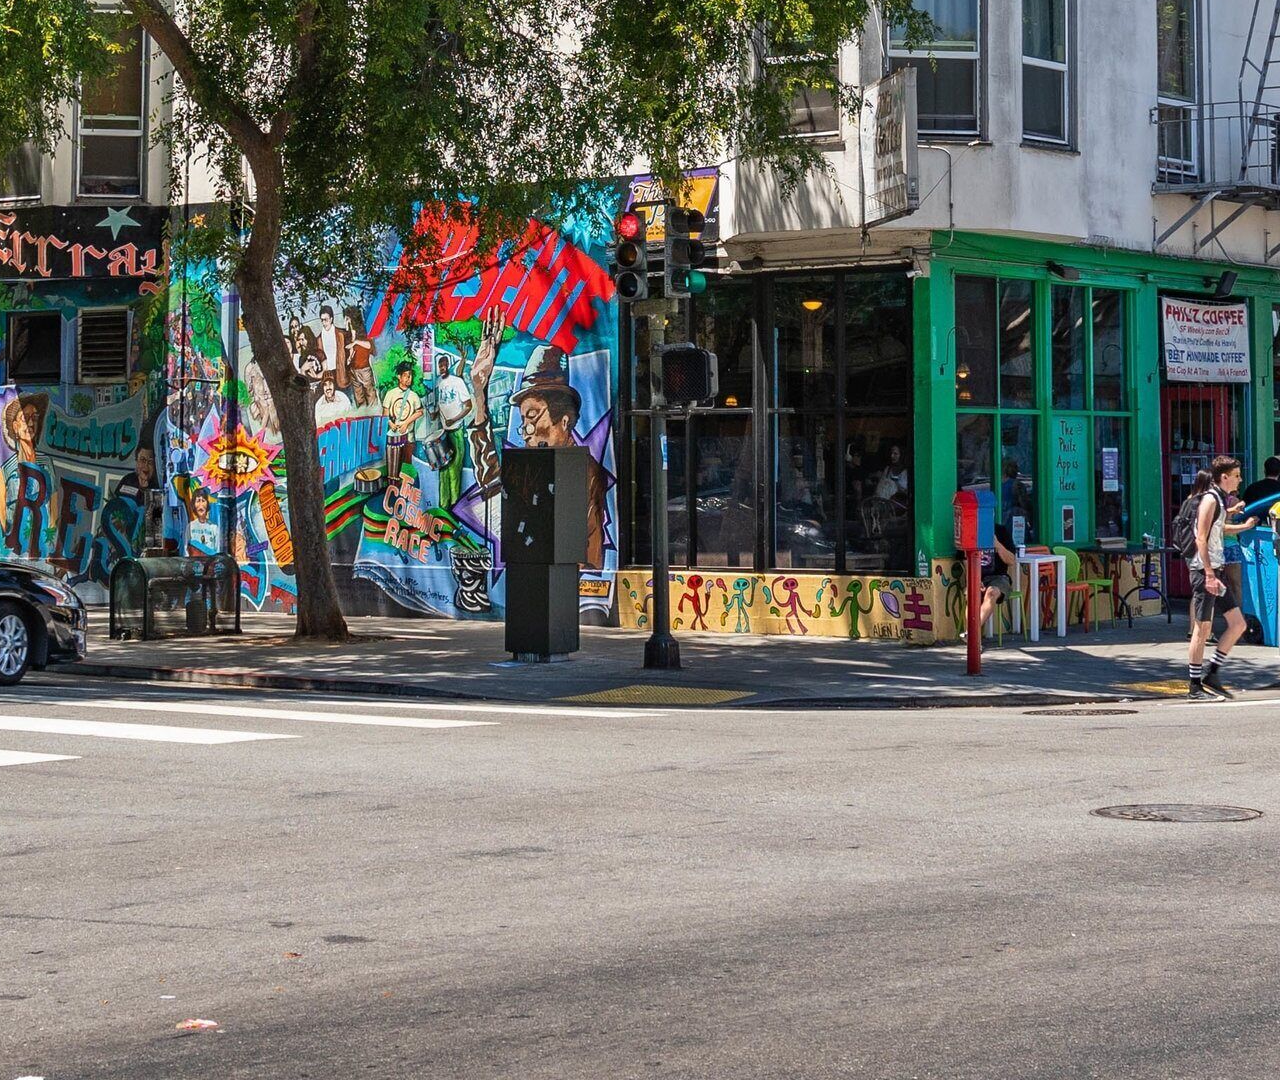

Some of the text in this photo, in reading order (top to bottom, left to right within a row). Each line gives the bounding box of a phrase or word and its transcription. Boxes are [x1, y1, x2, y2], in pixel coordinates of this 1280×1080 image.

[1166, 305, 1244, 325] PHIL'Z COFFEE
[1179, 325, 1187, 333] SF
[1186, 351, 1219, 362] HANDMADE
[1060, 420, 1074, 436] The
[317, 416, 389, 484] FAMILY
[1056, 455, 1079, 475] App is
[399, 472, 422, 505] THE
[1059, 477, 1076, 491] Here
[383, 485, 445, 543] COSMIC
[383, 518, 433, 564] RACE
